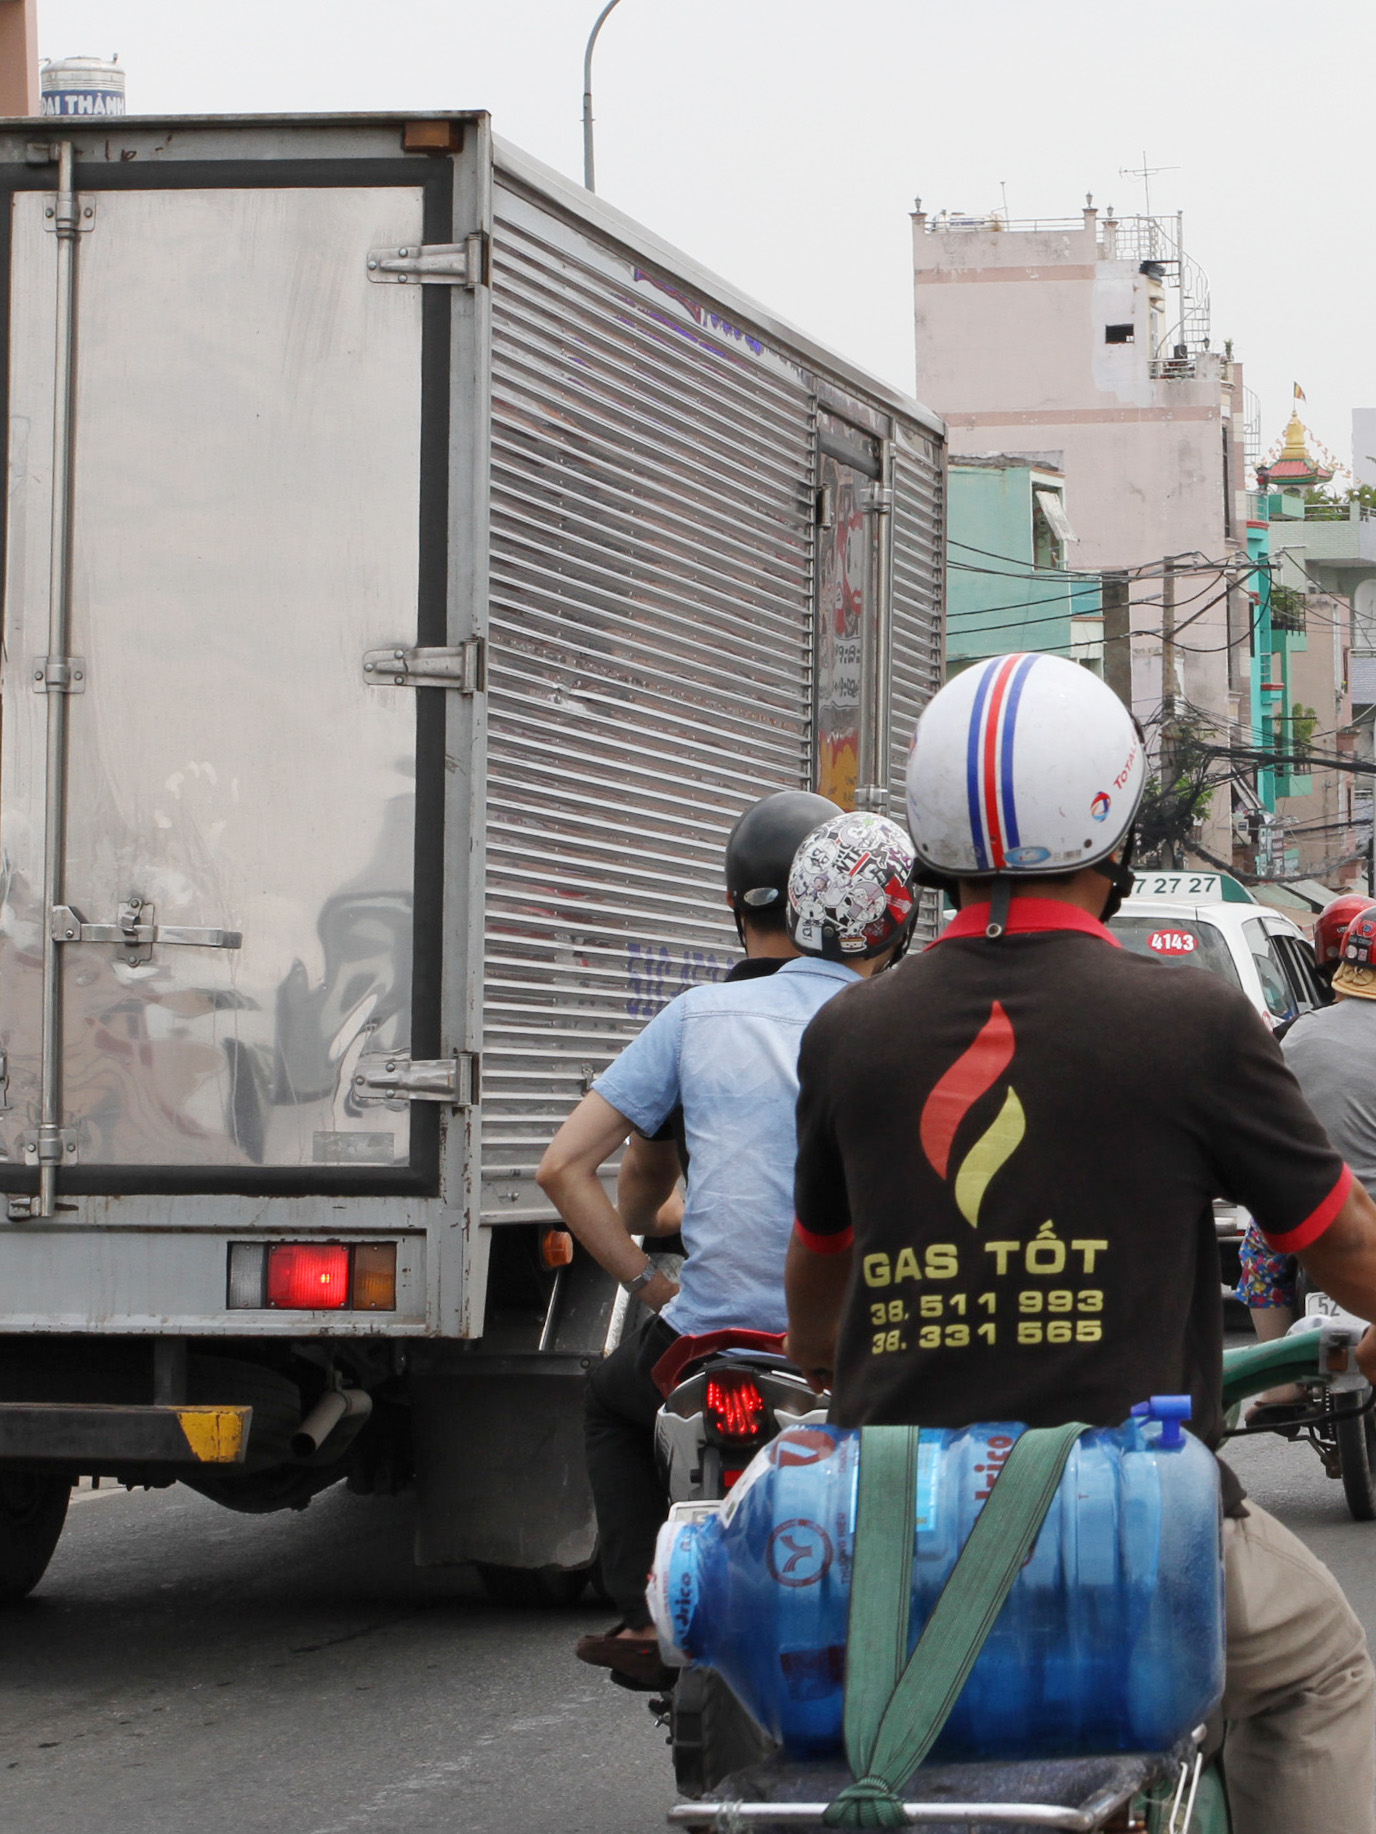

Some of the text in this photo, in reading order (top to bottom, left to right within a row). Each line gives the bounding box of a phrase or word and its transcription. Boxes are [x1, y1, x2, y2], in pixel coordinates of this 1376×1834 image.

[65, 92, 125, 115] THÀNH
[1154, 878, 1181, 893] 27
[1188, 877, 1216, 893] 27
[1151, 933, 1194, 950] 4143
[863, 1219, 1109, 1287] GAS TỐT
[920, 1292, 997, 1318] 511
[1018, 1290, 1103, 1314] 993
[919, 1322, 997, 1348] 331
[1017, 1320, 1102, 1344] 565
